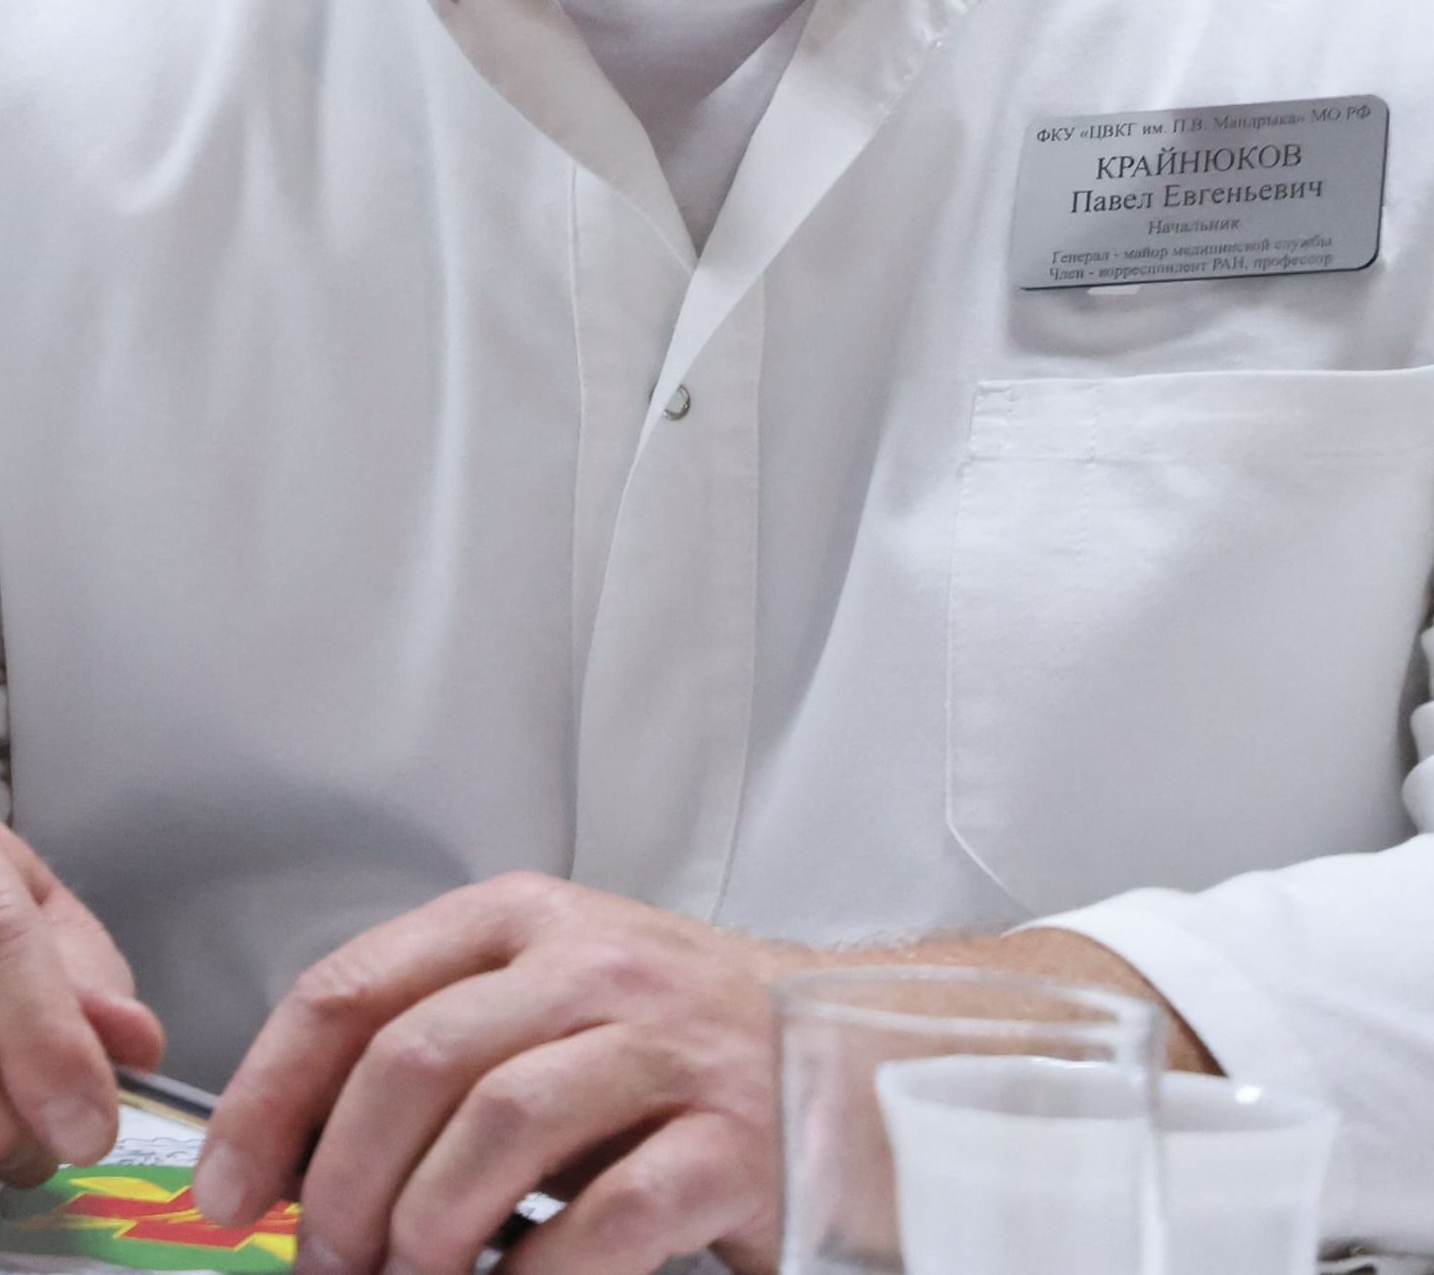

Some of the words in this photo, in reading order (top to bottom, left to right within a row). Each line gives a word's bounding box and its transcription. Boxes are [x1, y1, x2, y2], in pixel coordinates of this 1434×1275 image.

[1036, 126, 1076, 143] ФКУ
[1080, 121, 1137, 140] «ЦВКГ
[1311, 107, 1342, 123] МО
[1346, 104, 1372, 120] РФ
[1095, 143, 1303, 181] КРАЙНЮКОВ
[1069, 188, 1154, 215] Павел
[1162, 179, 1325, 210] Евгеньевич
[1147, 218, 1241, 236] Начальник
[1049, 267, 1085, 282] Член
[1097, 260, 1207, 280] корреспондент
[1253, 252, 1334, 272] профессор
[1051, 249, 1110, 266] Генерал
[1123, 245, 1169, 261] майор
